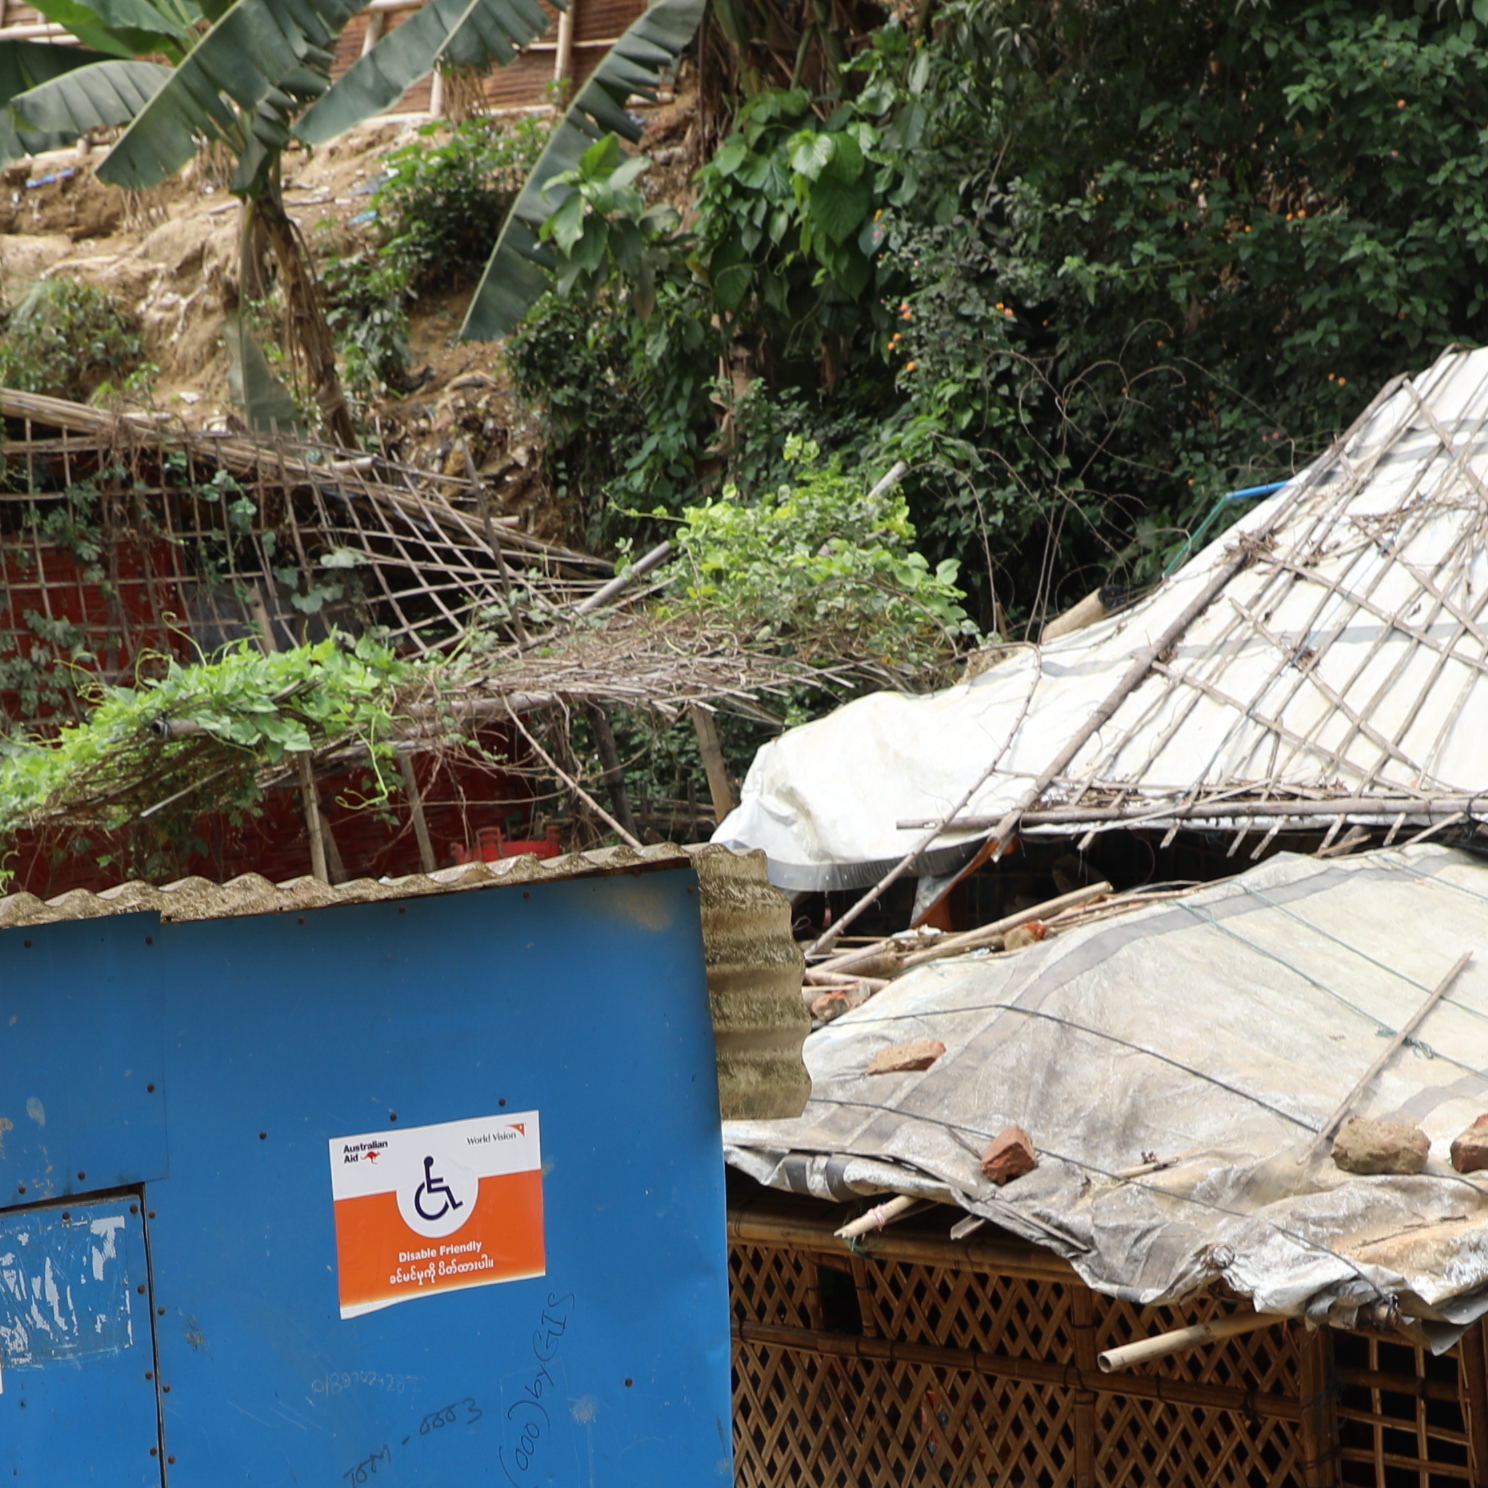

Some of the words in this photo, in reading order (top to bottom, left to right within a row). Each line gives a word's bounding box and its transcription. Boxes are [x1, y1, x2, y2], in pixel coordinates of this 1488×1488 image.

[466, 1134, 491, 1146] World
[492, 1130, 517, 1142] Vision
[343, 1140, 388, 1154] Australian
[343, 1154, 359, 1164] Aid
[398, 1248, 437, 1263] Disable
[439, 1240, 482, 1256] Friendly
[532, 1292, 575, 1362] GIS
